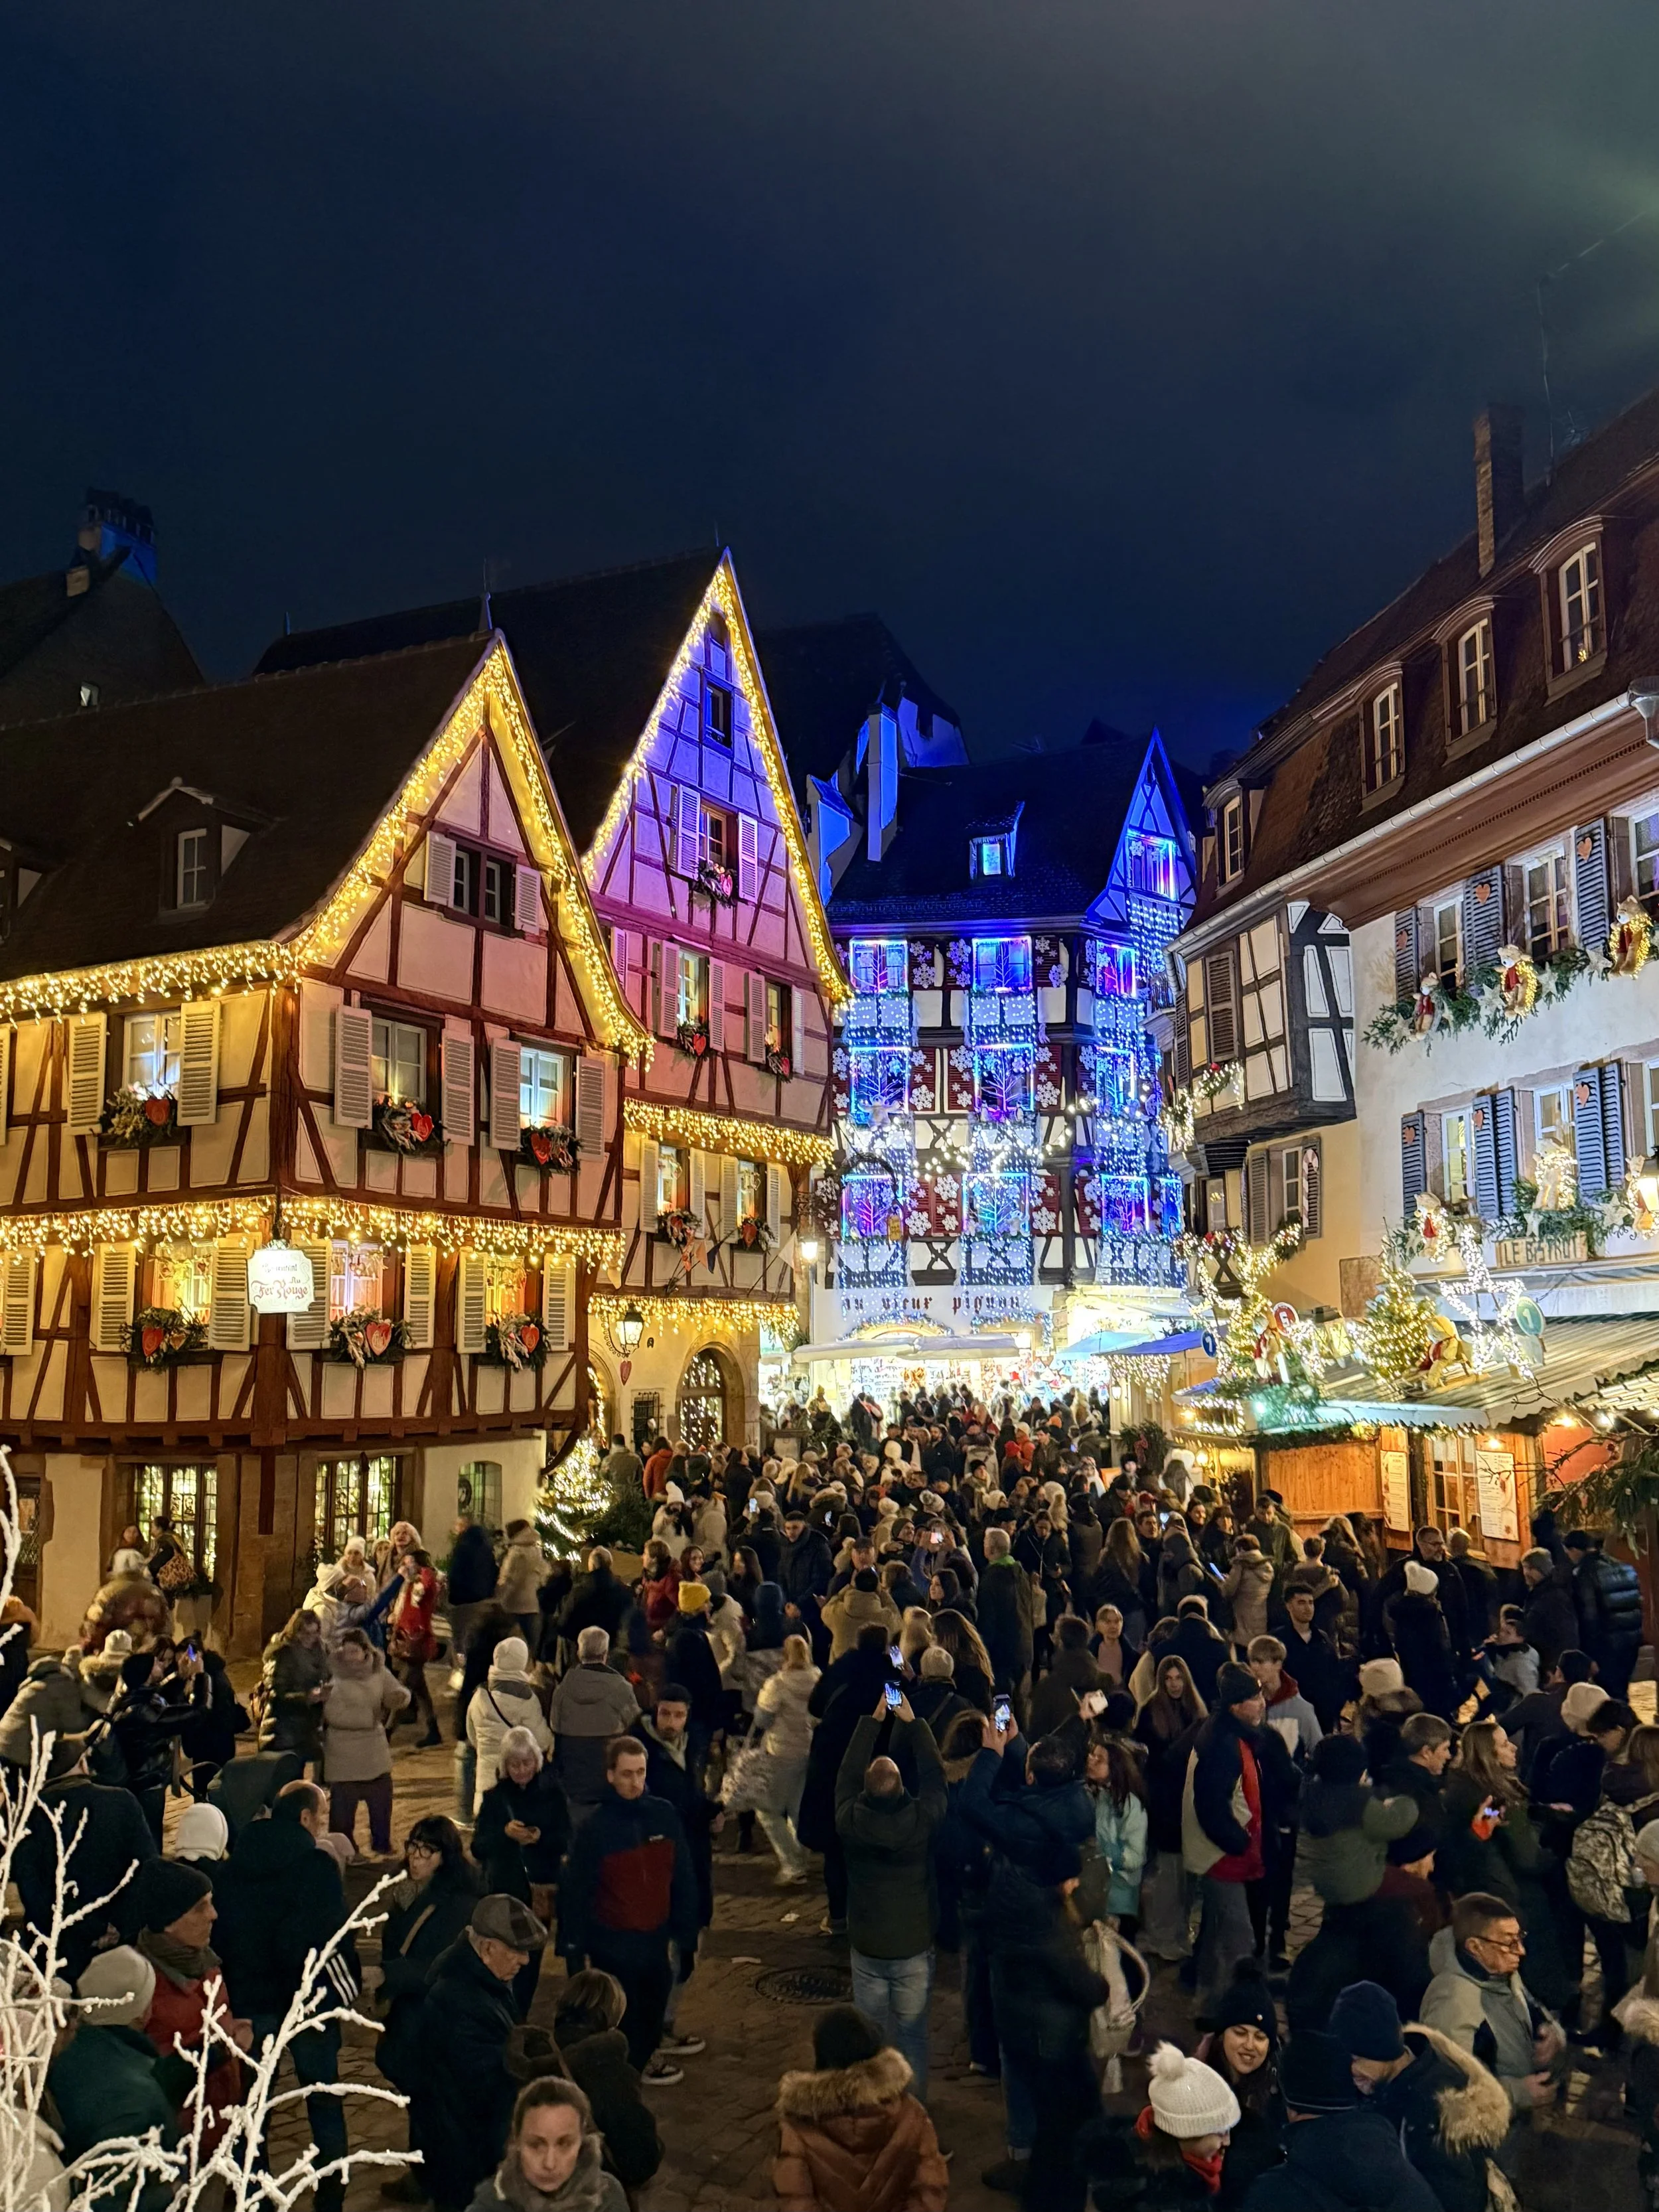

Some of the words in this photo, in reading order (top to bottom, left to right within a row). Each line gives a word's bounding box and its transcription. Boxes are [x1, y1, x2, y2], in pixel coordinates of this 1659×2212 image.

[1504, 1241, 1520, 1264] LE
[251, 1280, 275, 1303] Fer
[273, 1278, 309, 1300] Rouge
[289, 1276, 301, 1284] Au
[952, 1290, 1020, 1316] pignon
[1522, 1308, 1534, 1329] 1
[1204, 1335, 1214, 1353] 1
